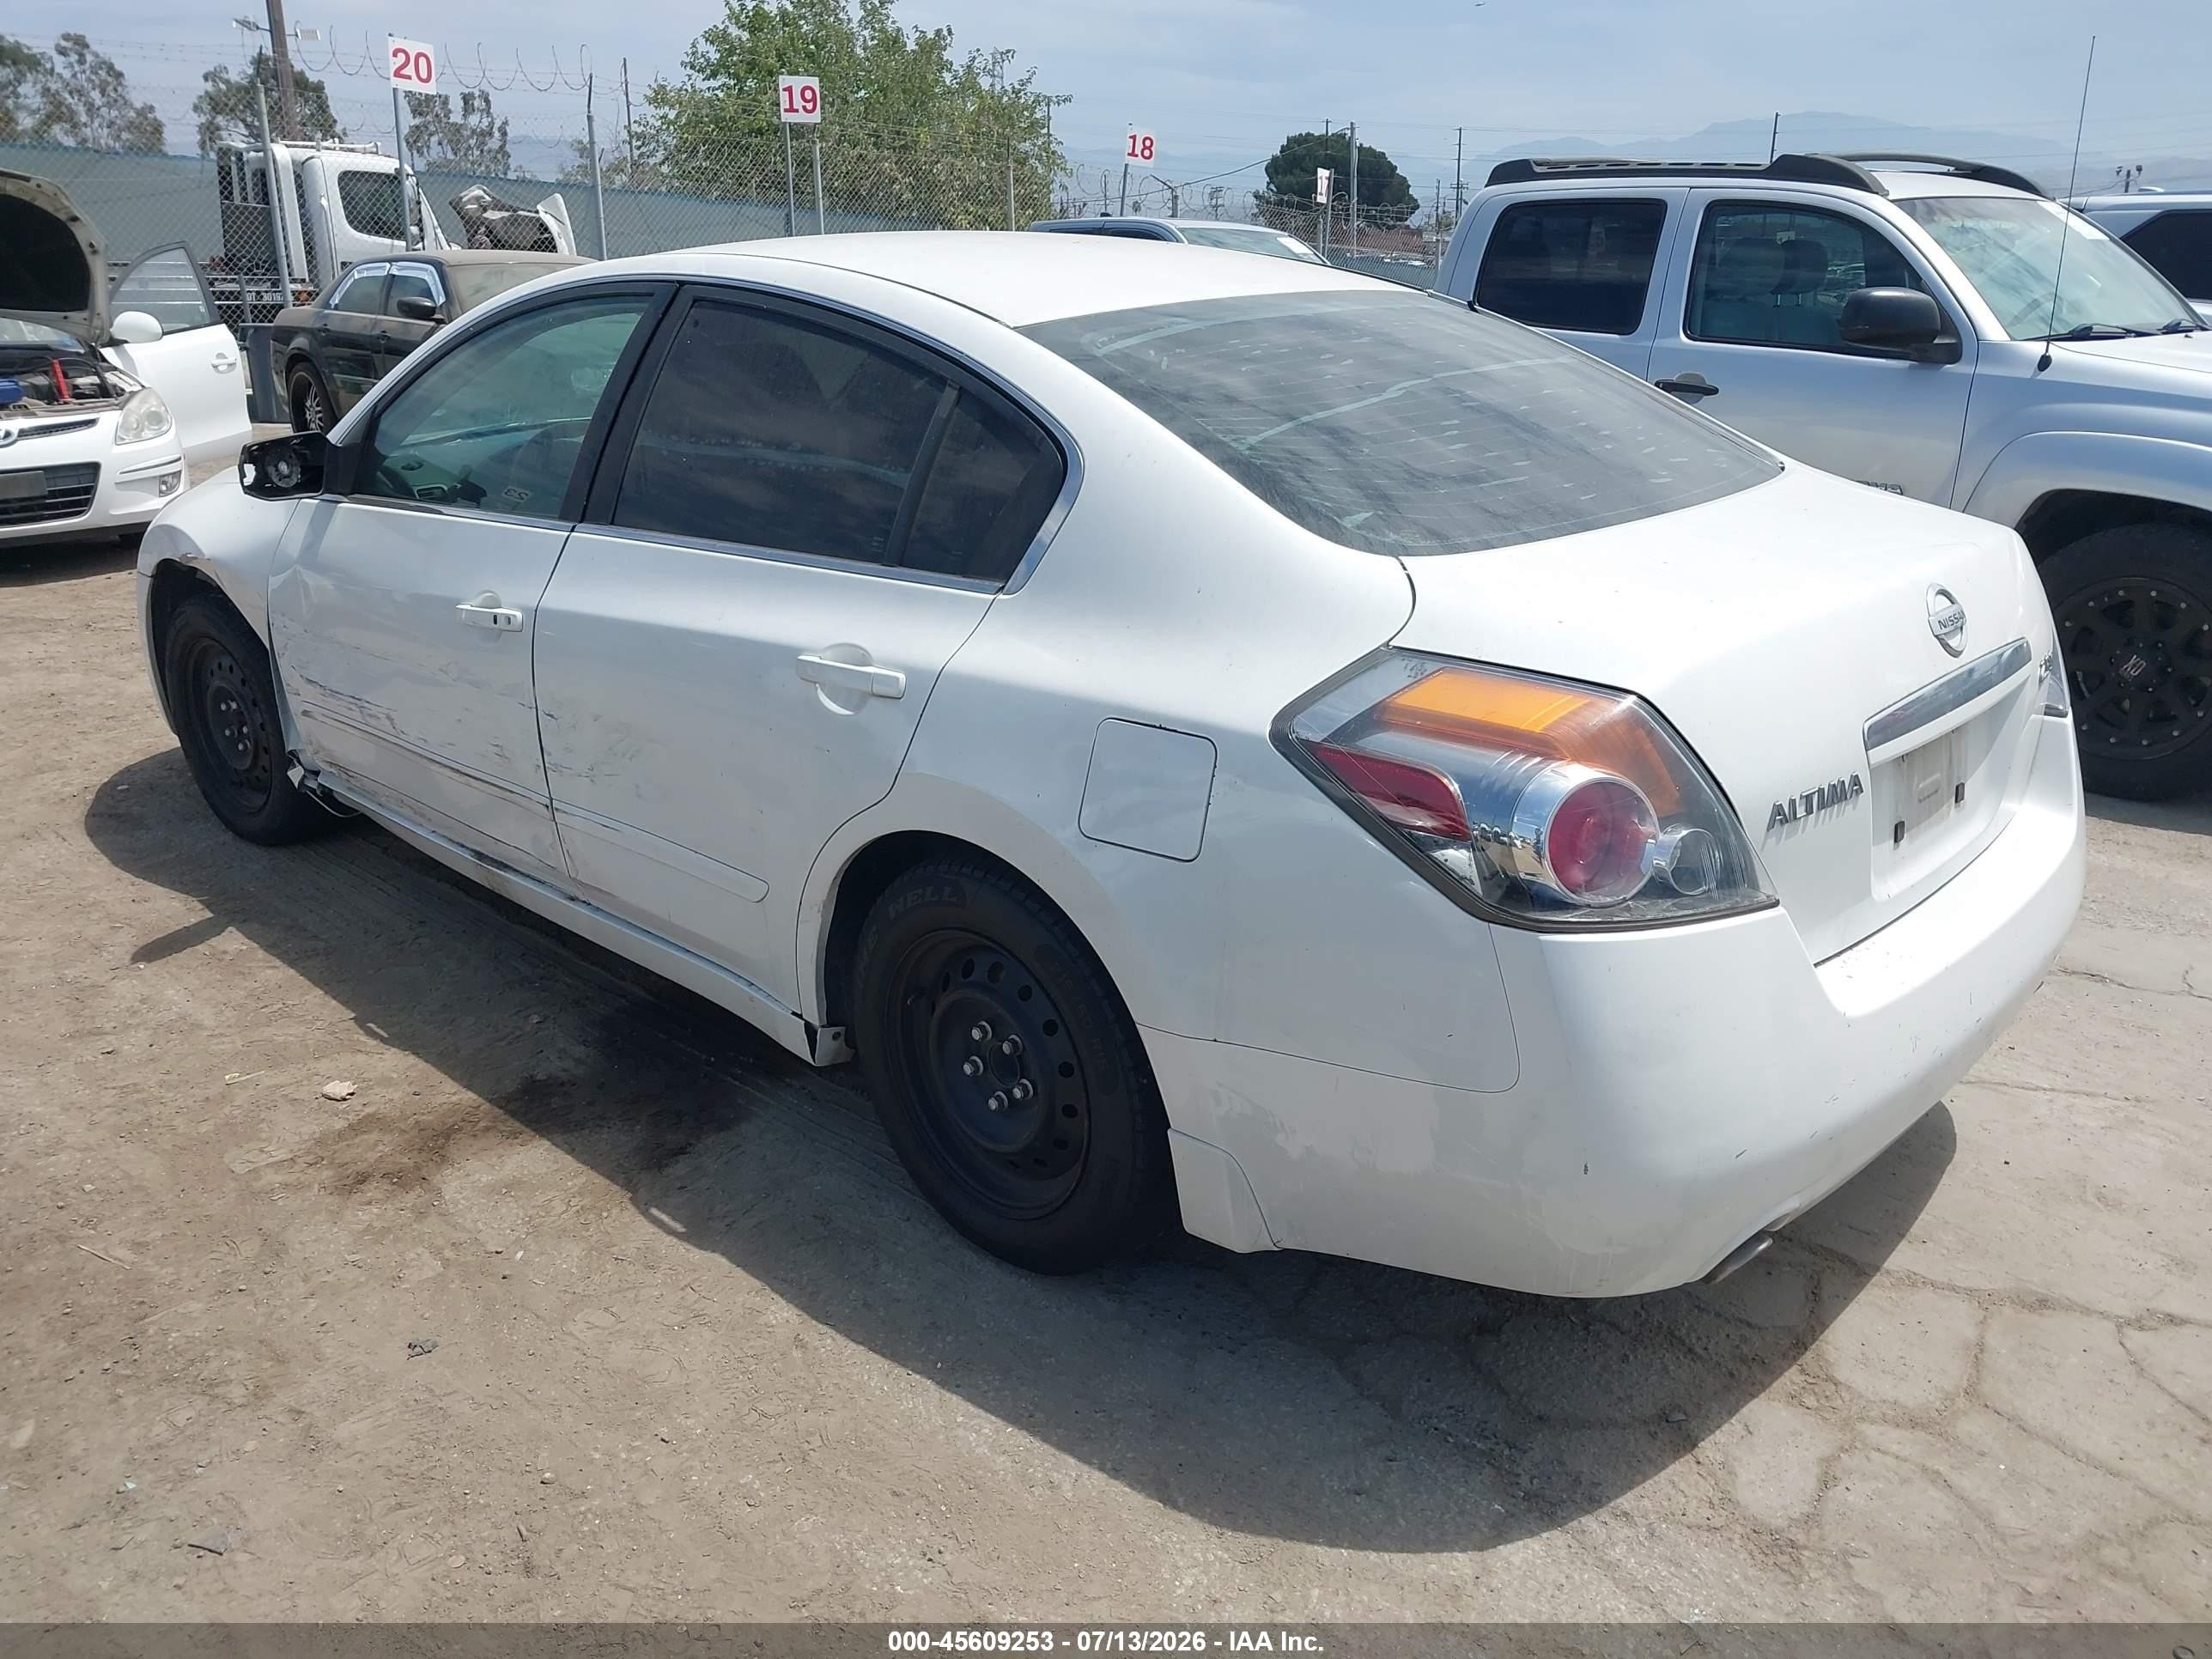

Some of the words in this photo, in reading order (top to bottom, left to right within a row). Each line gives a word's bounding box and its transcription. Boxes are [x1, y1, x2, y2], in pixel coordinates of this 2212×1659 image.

[392, 47, 432, 83] 20
[782, 84, 817, 114] 19
[1127, 134, 1154, 161] 18
[1319, 175, 1329, 198] 17
[1765, 771, 1864, 832] ALTIMA
